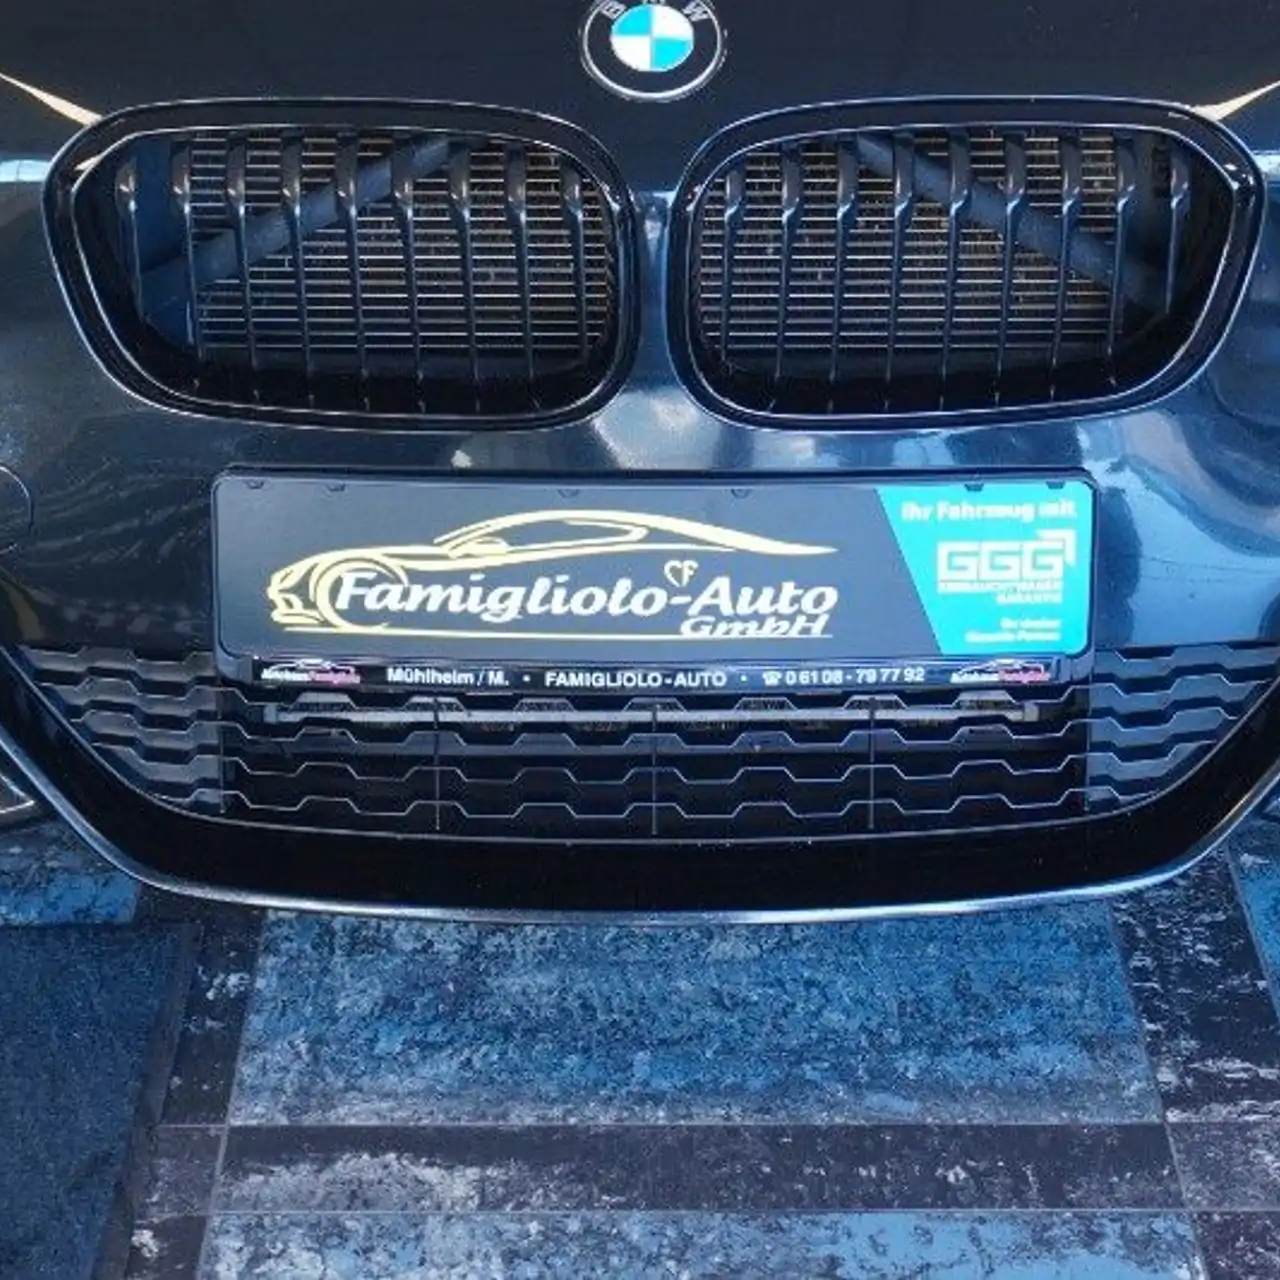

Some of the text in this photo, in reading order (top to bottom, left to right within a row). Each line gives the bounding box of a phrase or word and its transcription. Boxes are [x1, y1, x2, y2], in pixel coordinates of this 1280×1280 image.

[936, 539, 1065, 581] GGG
[334, 571, 839, 623] Famigliolo-Auto
[678, 615, 830, 639] GmbH
[386, 666, 474, 685] Mühlheim
